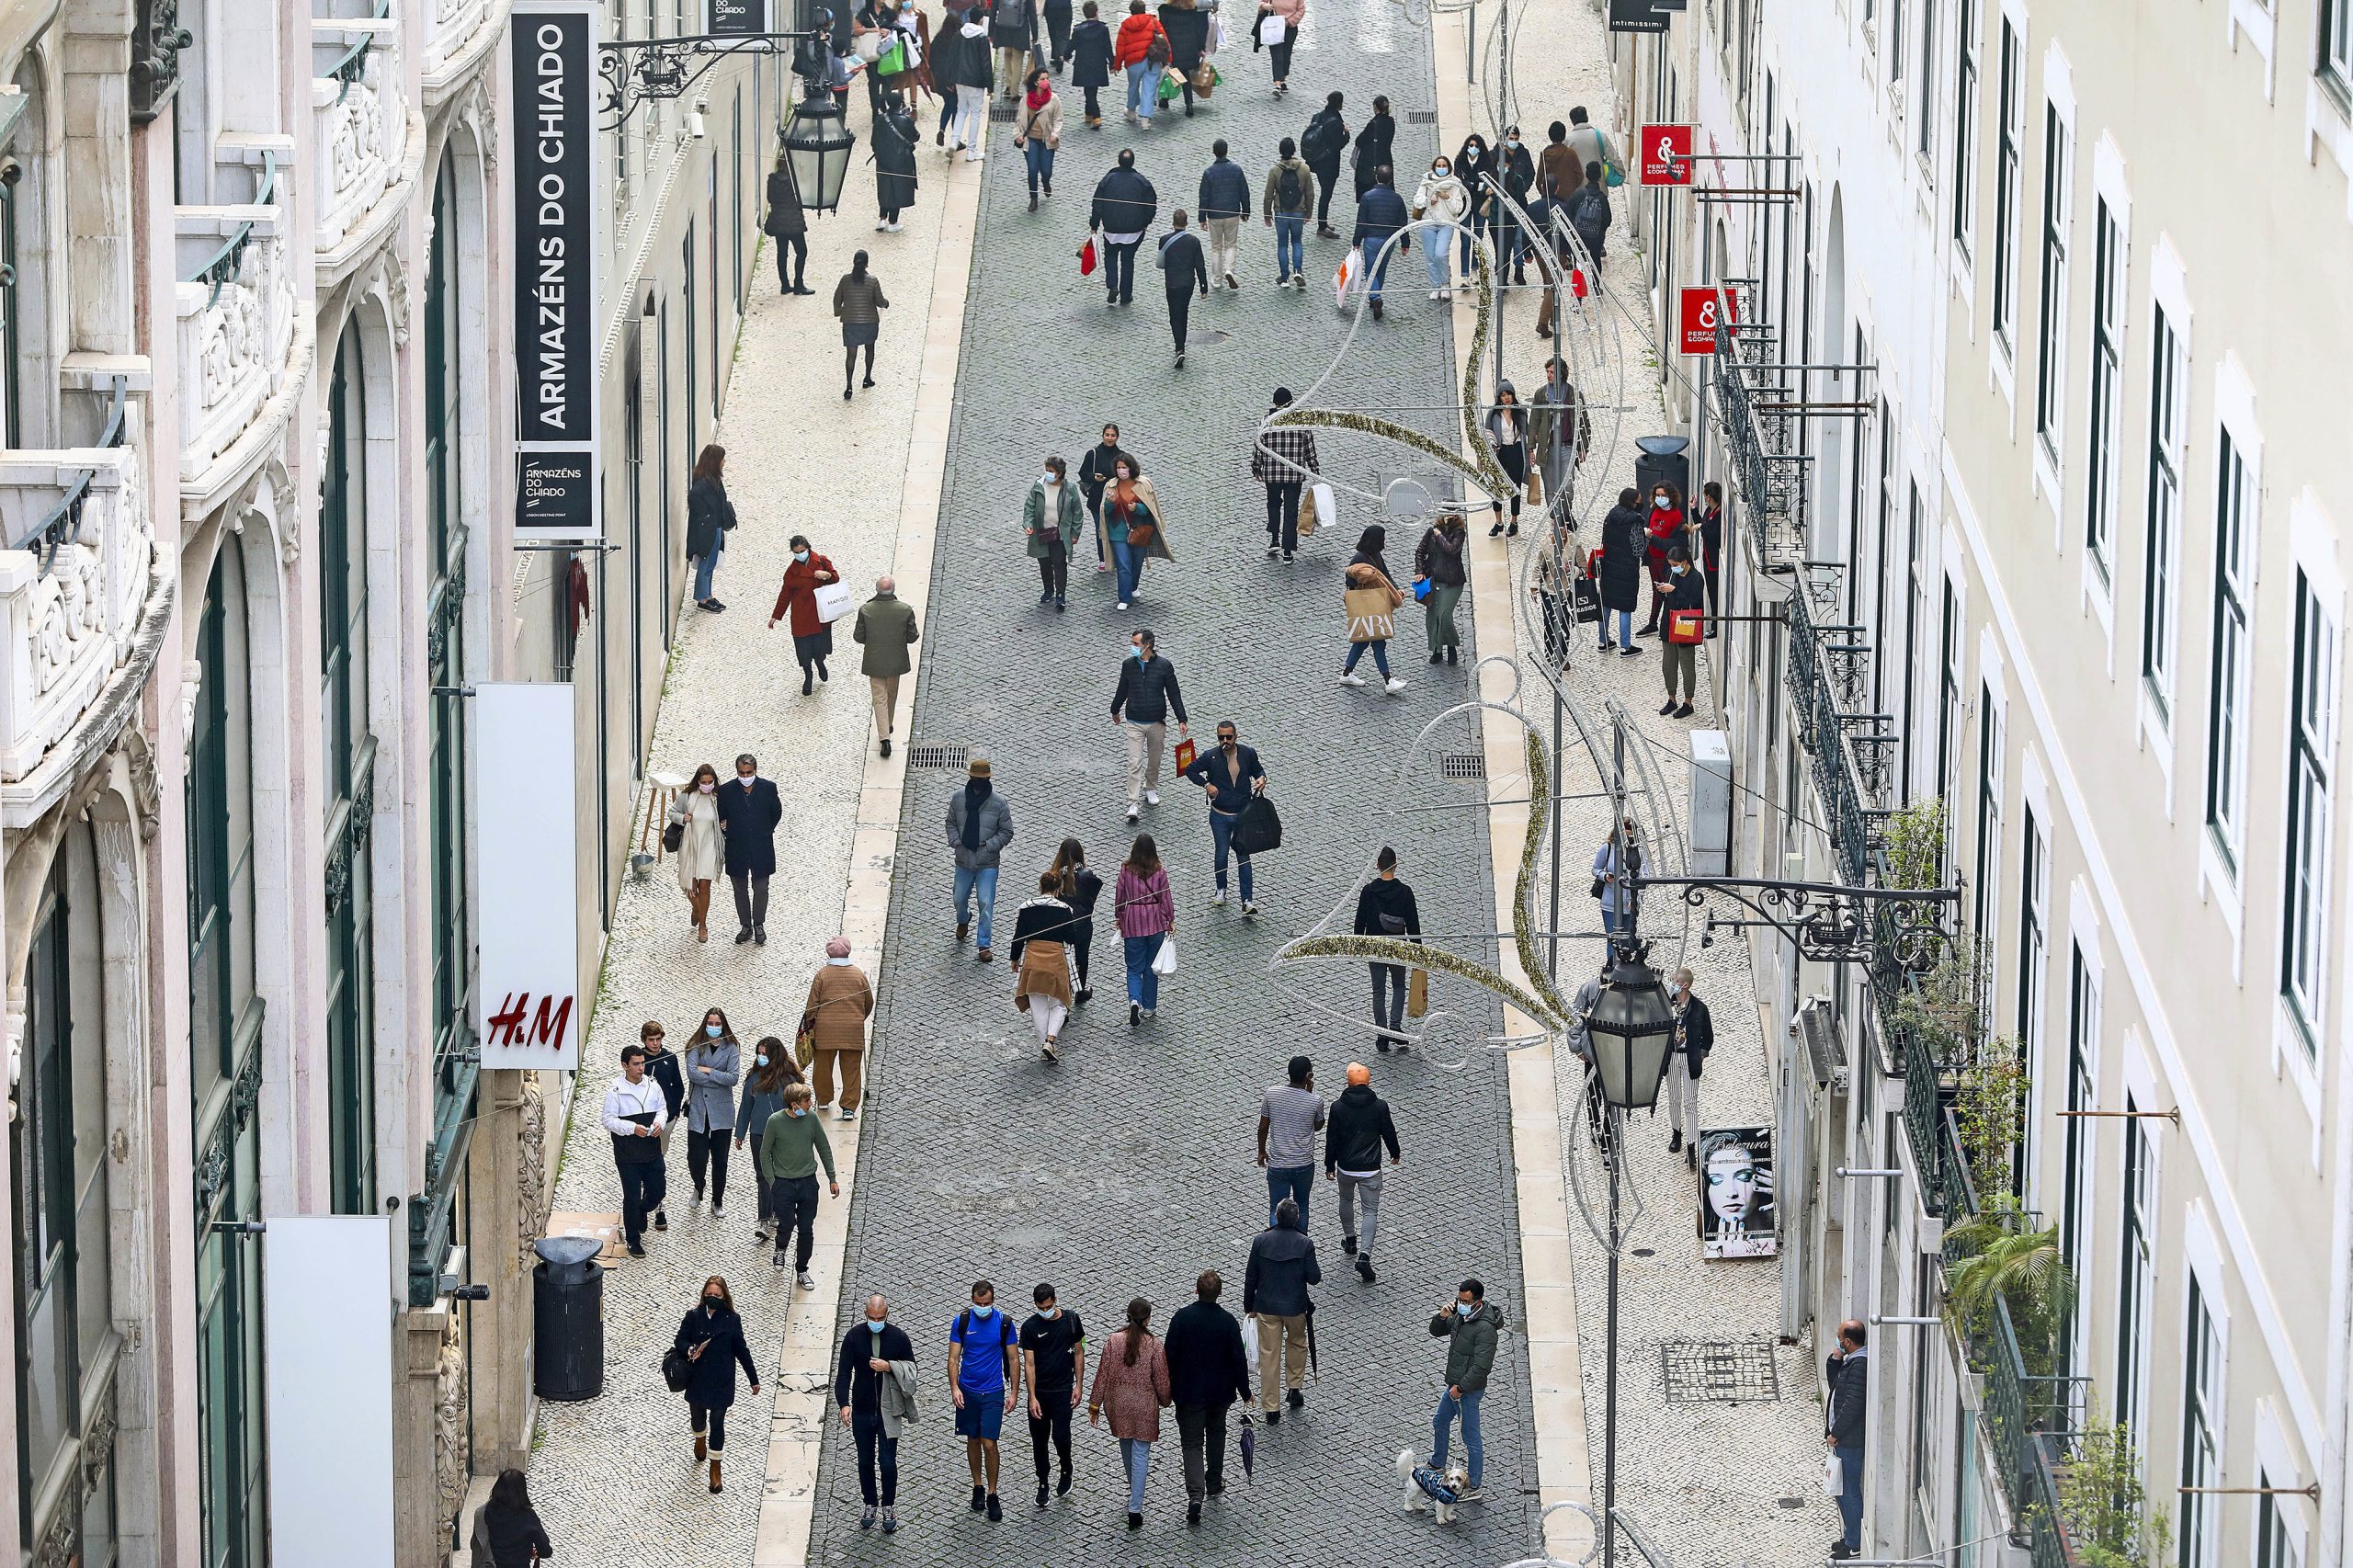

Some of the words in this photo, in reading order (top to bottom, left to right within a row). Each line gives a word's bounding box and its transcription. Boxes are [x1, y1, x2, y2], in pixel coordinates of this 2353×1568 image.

[536, 23, 564, 164] CHIADO
[538, 173, 565, 226] DO
[531, 236, 566, 430] ARMAZÉNS
[526, 467, 582, 478] ARMAZÉNS
[526, 478, 542, 488] DO
[526, 487, 566, 497] CHIADO
[827, 596, 849, 606] MANGO
[1576, 603, 1597, 613] EASIDE
[1347, 613, 1394, 639] ZARA
[487, 991, 574, 1051] H&M
[1707, 1135, 1770, 1157] Belezura
